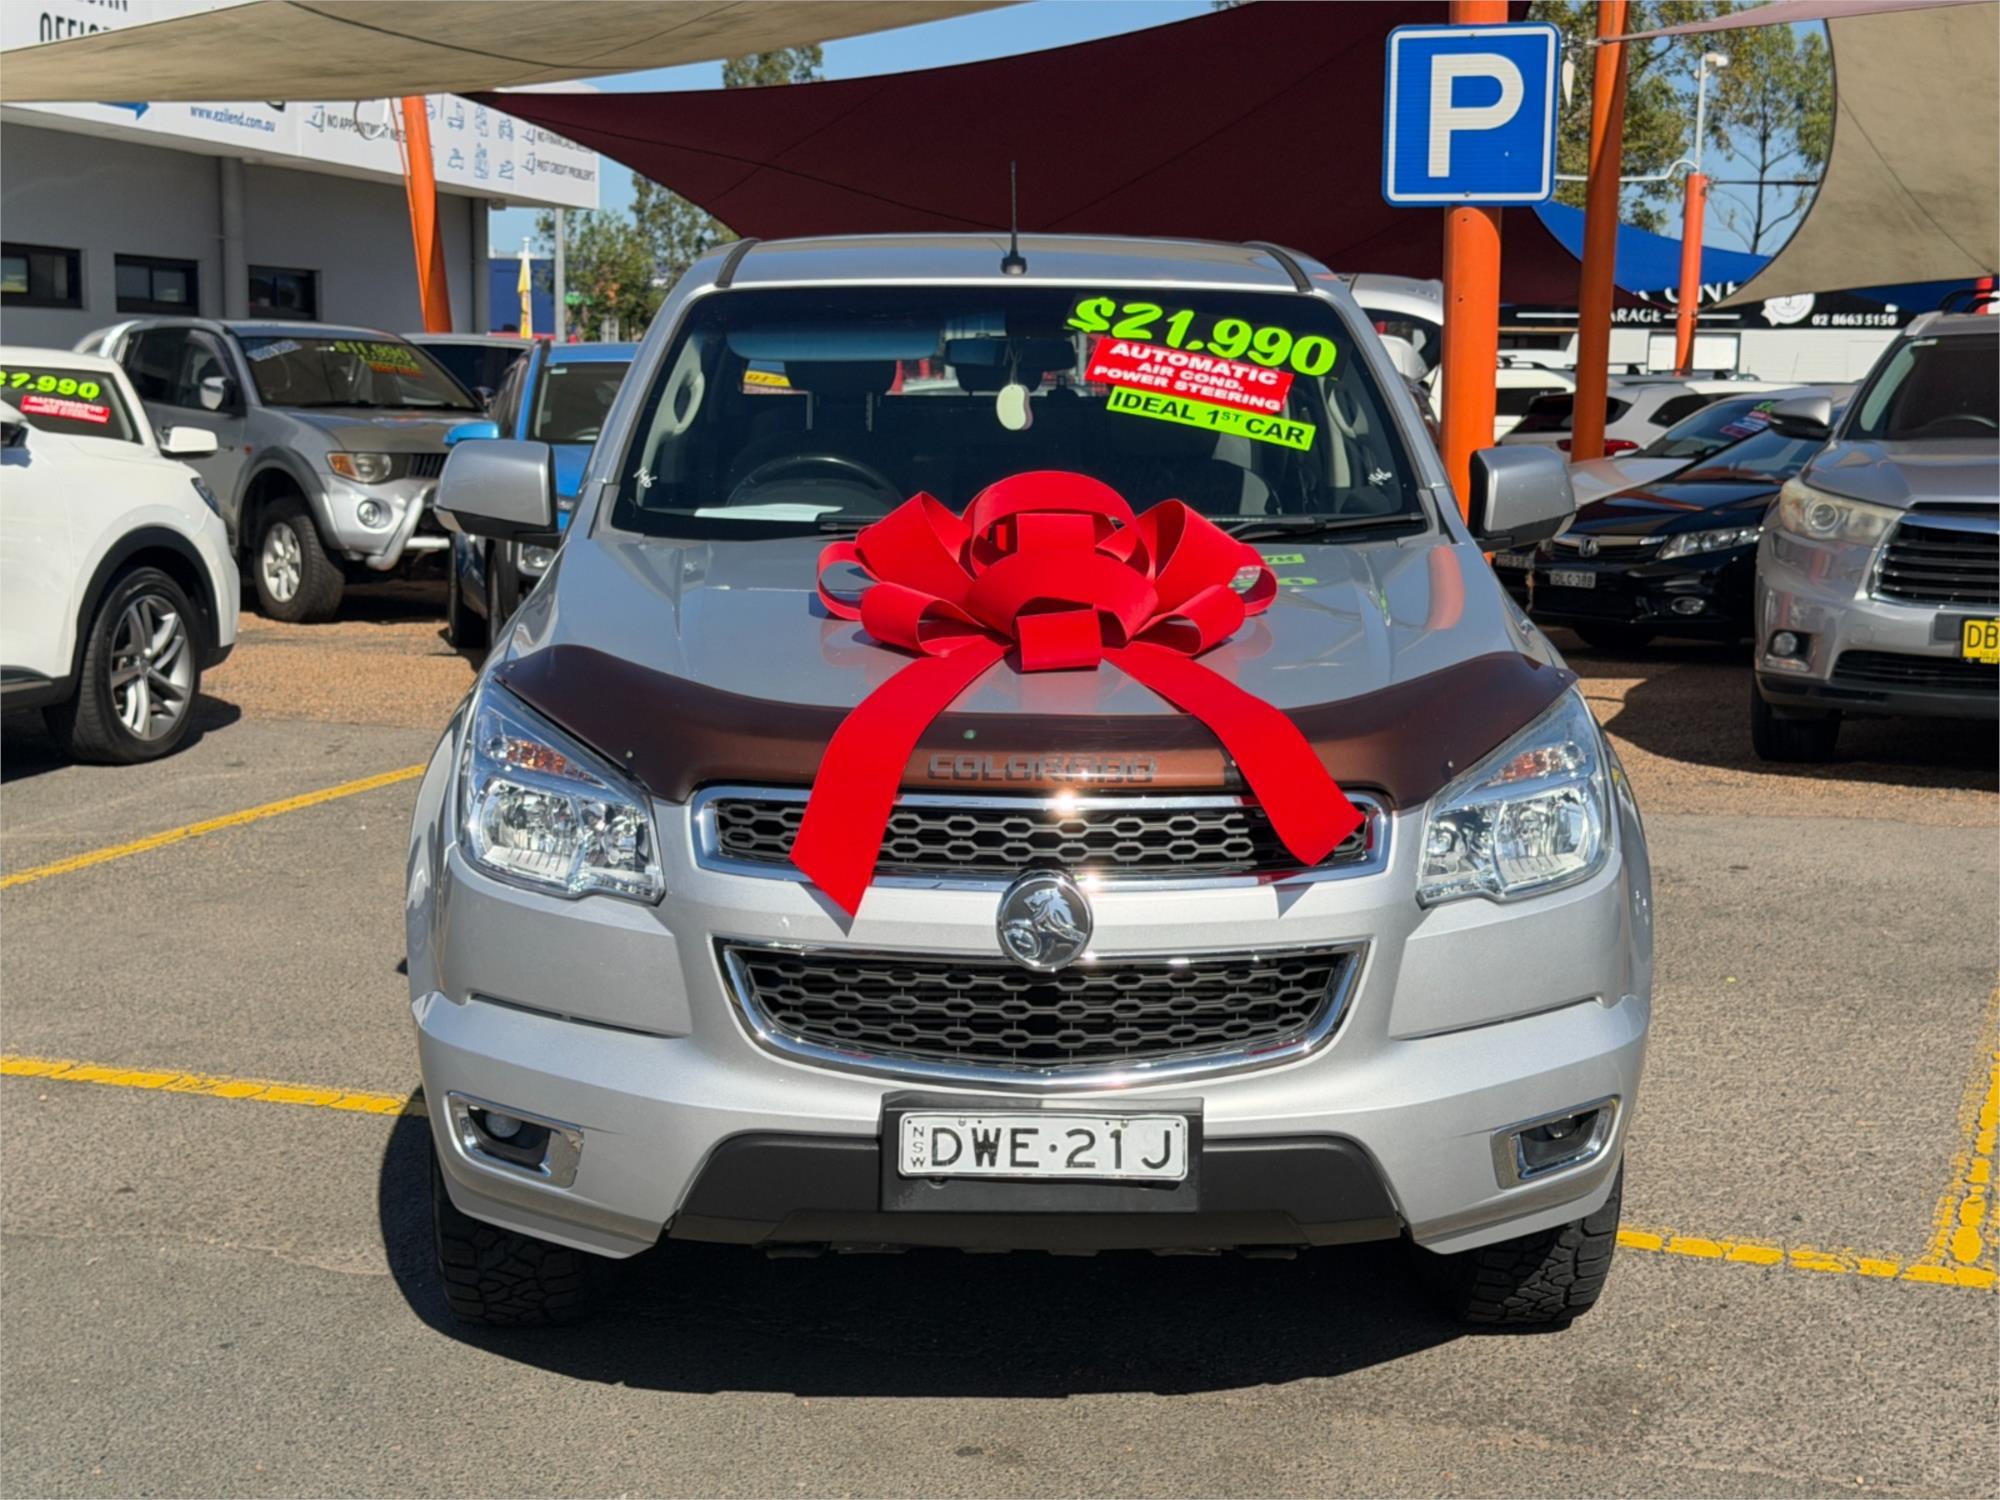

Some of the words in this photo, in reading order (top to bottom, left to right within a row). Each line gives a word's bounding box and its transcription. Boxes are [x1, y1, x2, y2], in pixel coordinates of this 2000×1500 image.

[40, 12, 111, 42] OFFI
[190, 105, 275, 132] www.ezilend.com.au
[1428, 53, 1524, 178] P
[1811, 312, 1827, 326] 02
[1831, 312, 1862, 326] 8663
[1864, 312, 1898, 326] 5150
[1110, 342, 1278, 386] AUTOMATIC
[1137, 362, 1174, 378] AIR
[1180, 370, 1244, 392] COND.
[1093, 365, 1169, 388] POWER
[1174, 380, 1281, 411] STEERING
[1113, 391, 1196, 421] IDEAL
[1206, 409, 1242, 425] 1ST
[1246, 417, 1305, 445] CAR
[928, 752, 1157, 783] COLORADO
